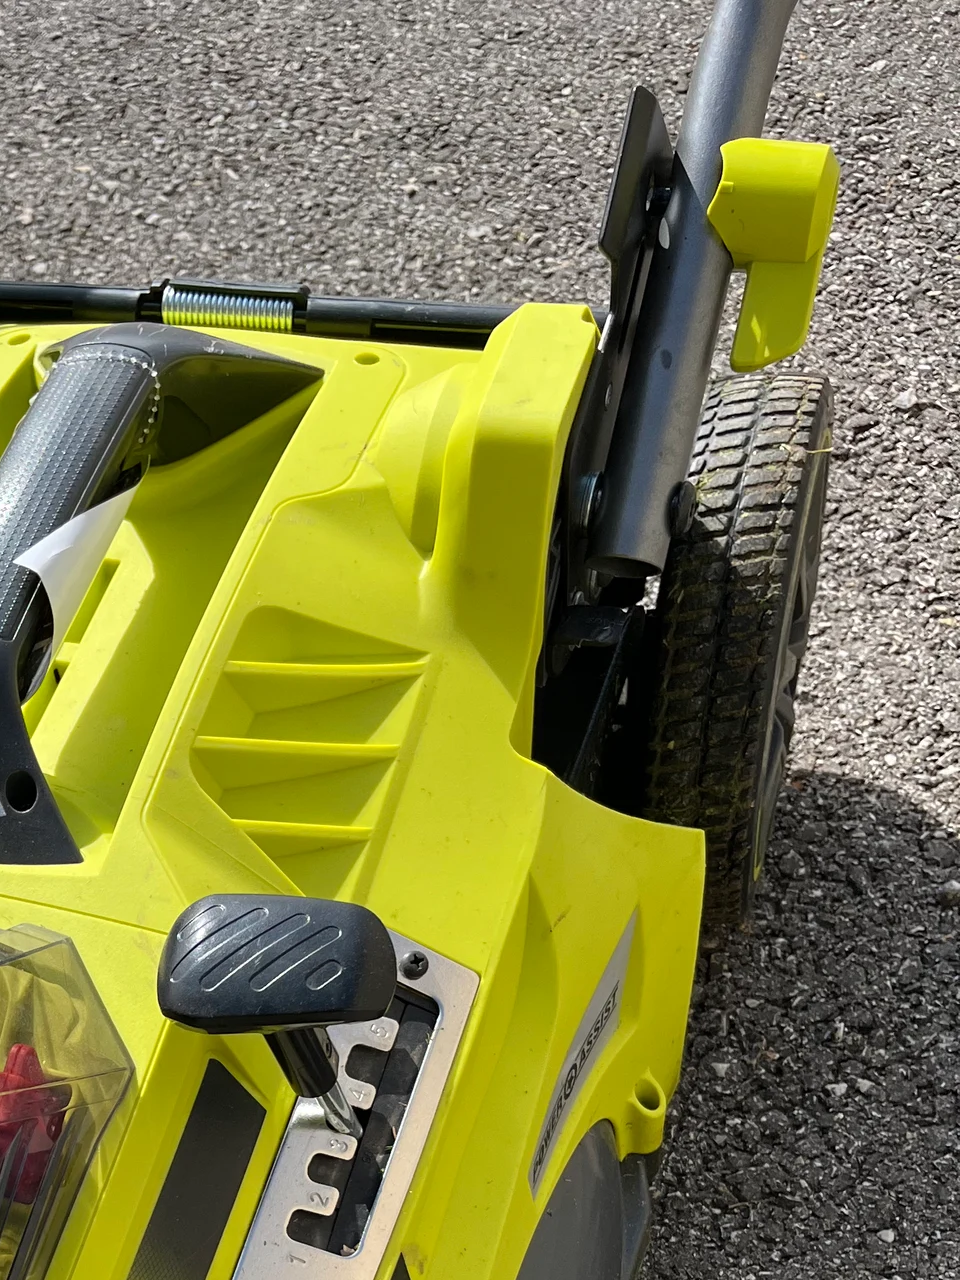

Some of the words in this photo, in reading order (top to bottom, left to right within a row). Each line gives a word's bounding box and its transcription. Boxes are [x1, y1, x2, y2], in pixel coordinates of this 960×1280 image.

[369, 1022, 389, 1040] 5
[578, 984, 619, 1070] ASSIST
[348, 1087, 370, 1102] 4
[329, 1138, 349, 1153] 3
[309, 1192, 330, 1208] 2
